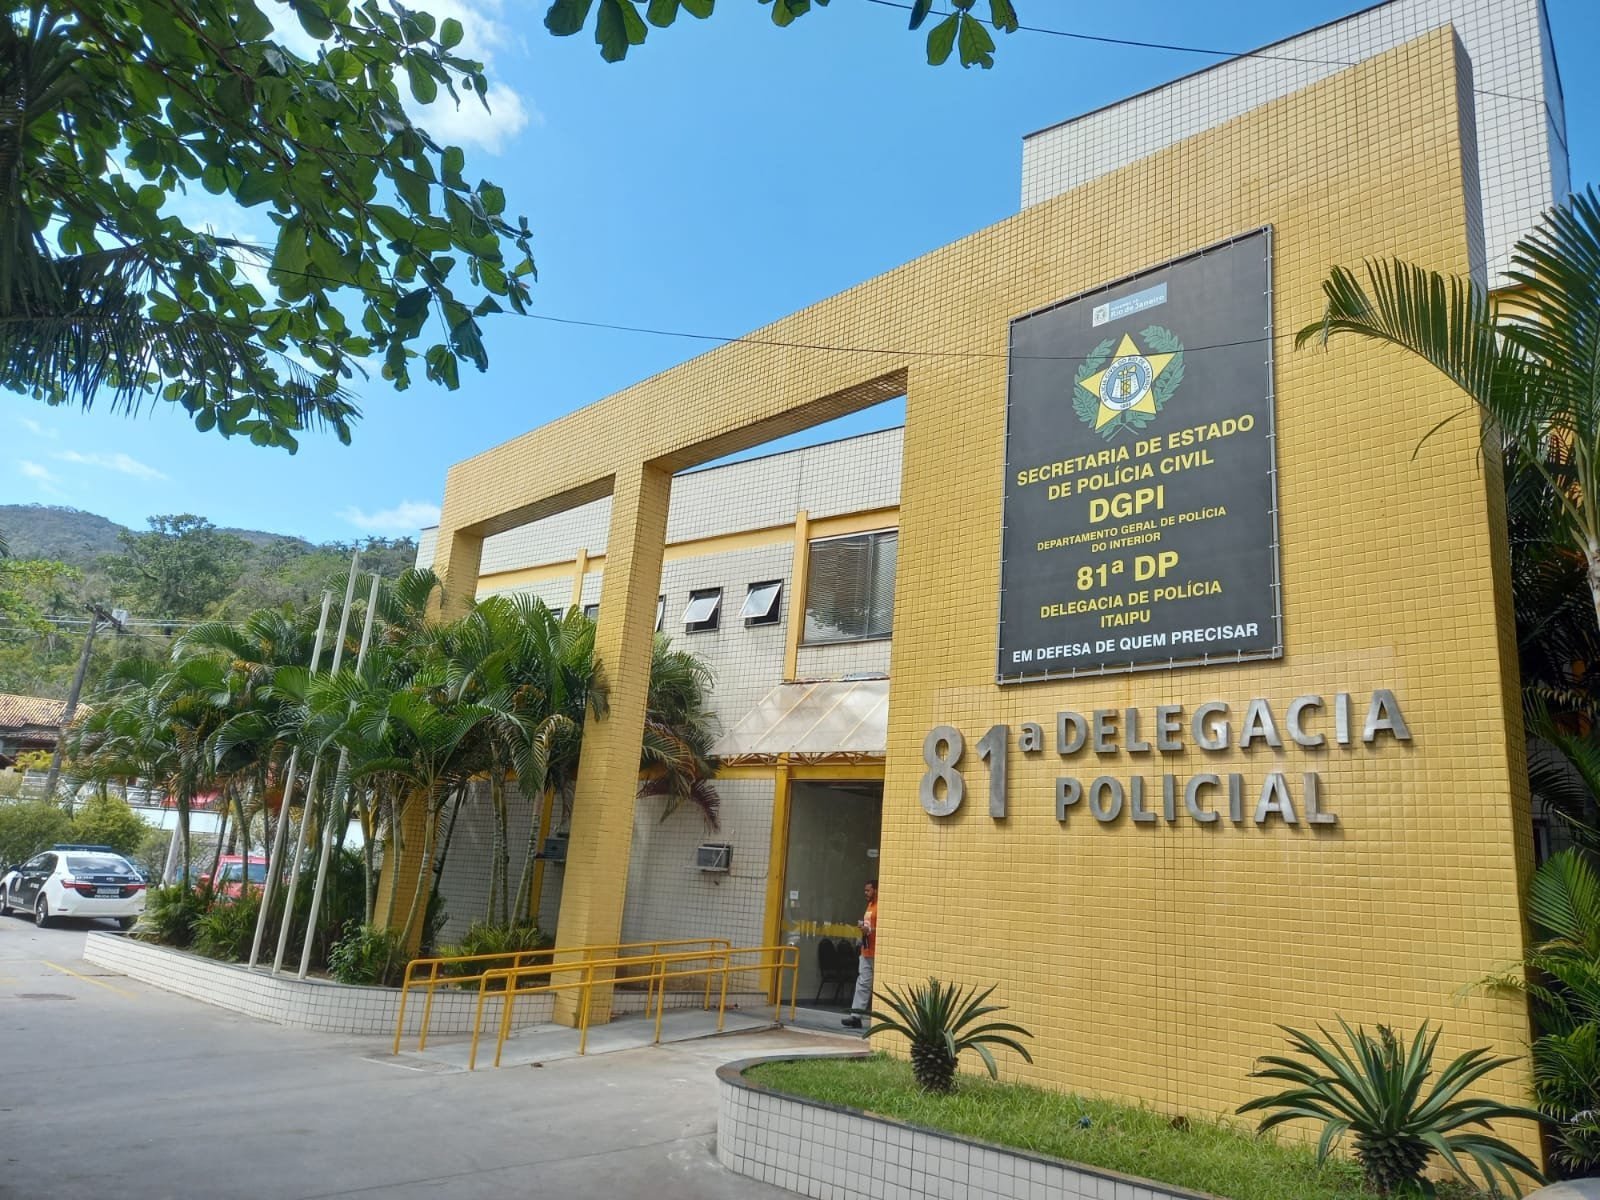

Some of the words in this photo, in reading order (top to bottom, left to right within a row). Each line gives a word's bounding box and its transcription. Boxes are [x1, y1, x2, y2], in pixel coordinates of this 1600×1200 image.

[1016, 445, 1130, 487] SECRETARIA
[1135, 436, 1162, 458] DE
[1168, 414, 1255, 450] ESTADO
[1048, 482, 1071, 501] DE
[1077, 461, 1155, 493] POLÍCIA
[1160, 448, 1215, 475] CIVIL
[1089, 484, 1165, 524] DGPI
[1036, 527, 1119, 551] DEPARTAMENTO
[1120, 520, 1157, 536] GERAL
[1160, 515, 1176, 527] DE
[1178, 506, 1227, 524] POLÍCIA
[1091, 541, 1108, 553] DO
[1109, 531, 1161, 550] INTERIOR
[1134, 550, 1180, 582] DP
[1040, 594, 1124, 619] DELEGACIA
[1128, 590, 1150, 606] DE
[1153, 579, 1223, 602] POLÍCIA
[1100, 609, 1151, 629] ITAIPU
[1012, 650, 1033, 663] EM
[1036, 642, 1092, 661] DEFESA
[1095, 639, 1116, 653] DE
[1119, 633, 1167, 650] QUEM
[1171, 622, 1259, 645] PRECISAR
[1055, 688, 1412, 755] DELEGACIA
[1055, 771, 1338, 824] POLICIAL
